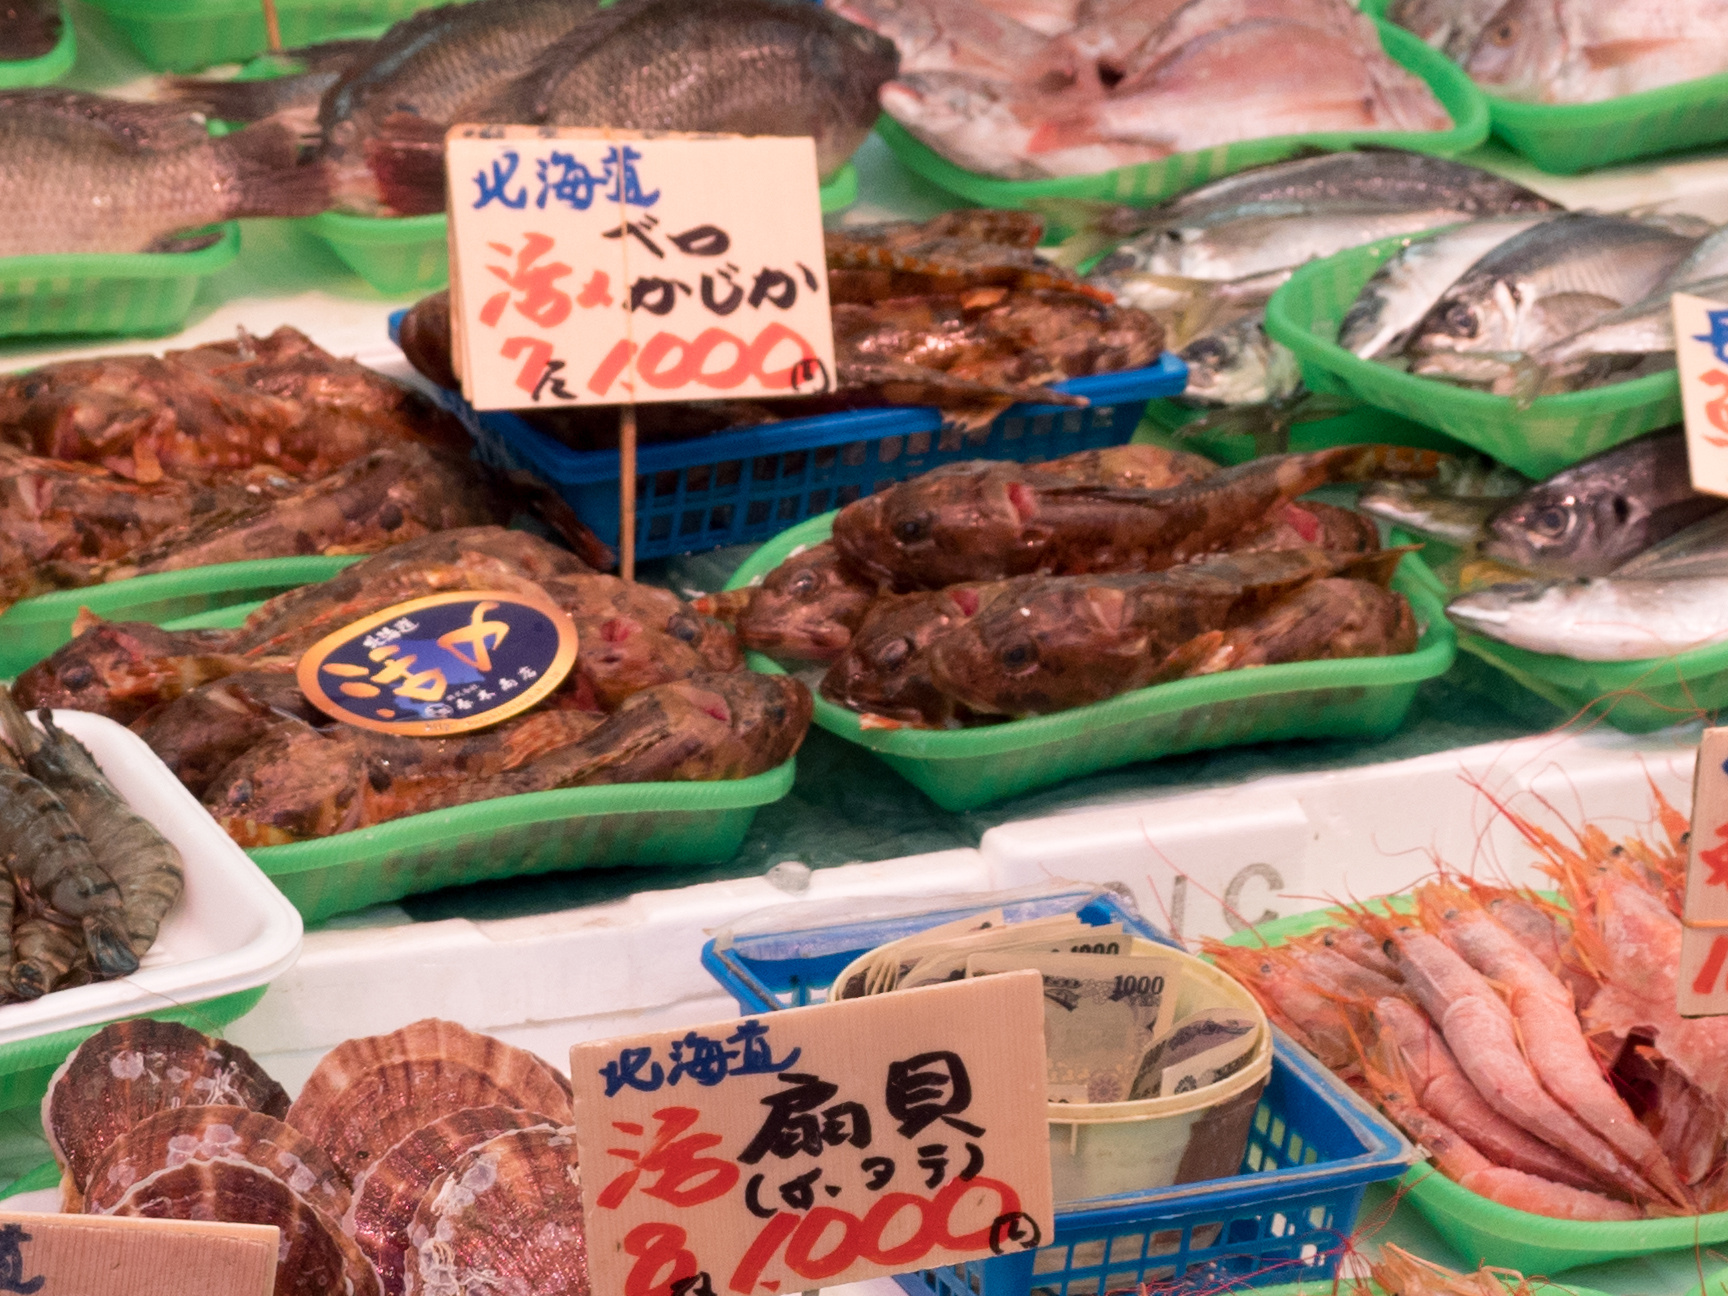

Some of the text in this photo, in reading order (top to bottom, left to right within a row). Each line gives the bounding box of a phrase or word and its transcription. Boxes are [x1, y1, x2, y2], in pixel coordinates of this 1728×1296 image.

[473, 146, 660, 210] 北海道
[602, 214, 730, 259] ベロ
[624, 262, 818, 316] かじか
[1113, 974, 1165, 998] 1000
[599, 1019, 802, 1097] 北海道
[737, 1050, 987, 1164] 扇貝
[597, 1106, 740, 1210] 活
